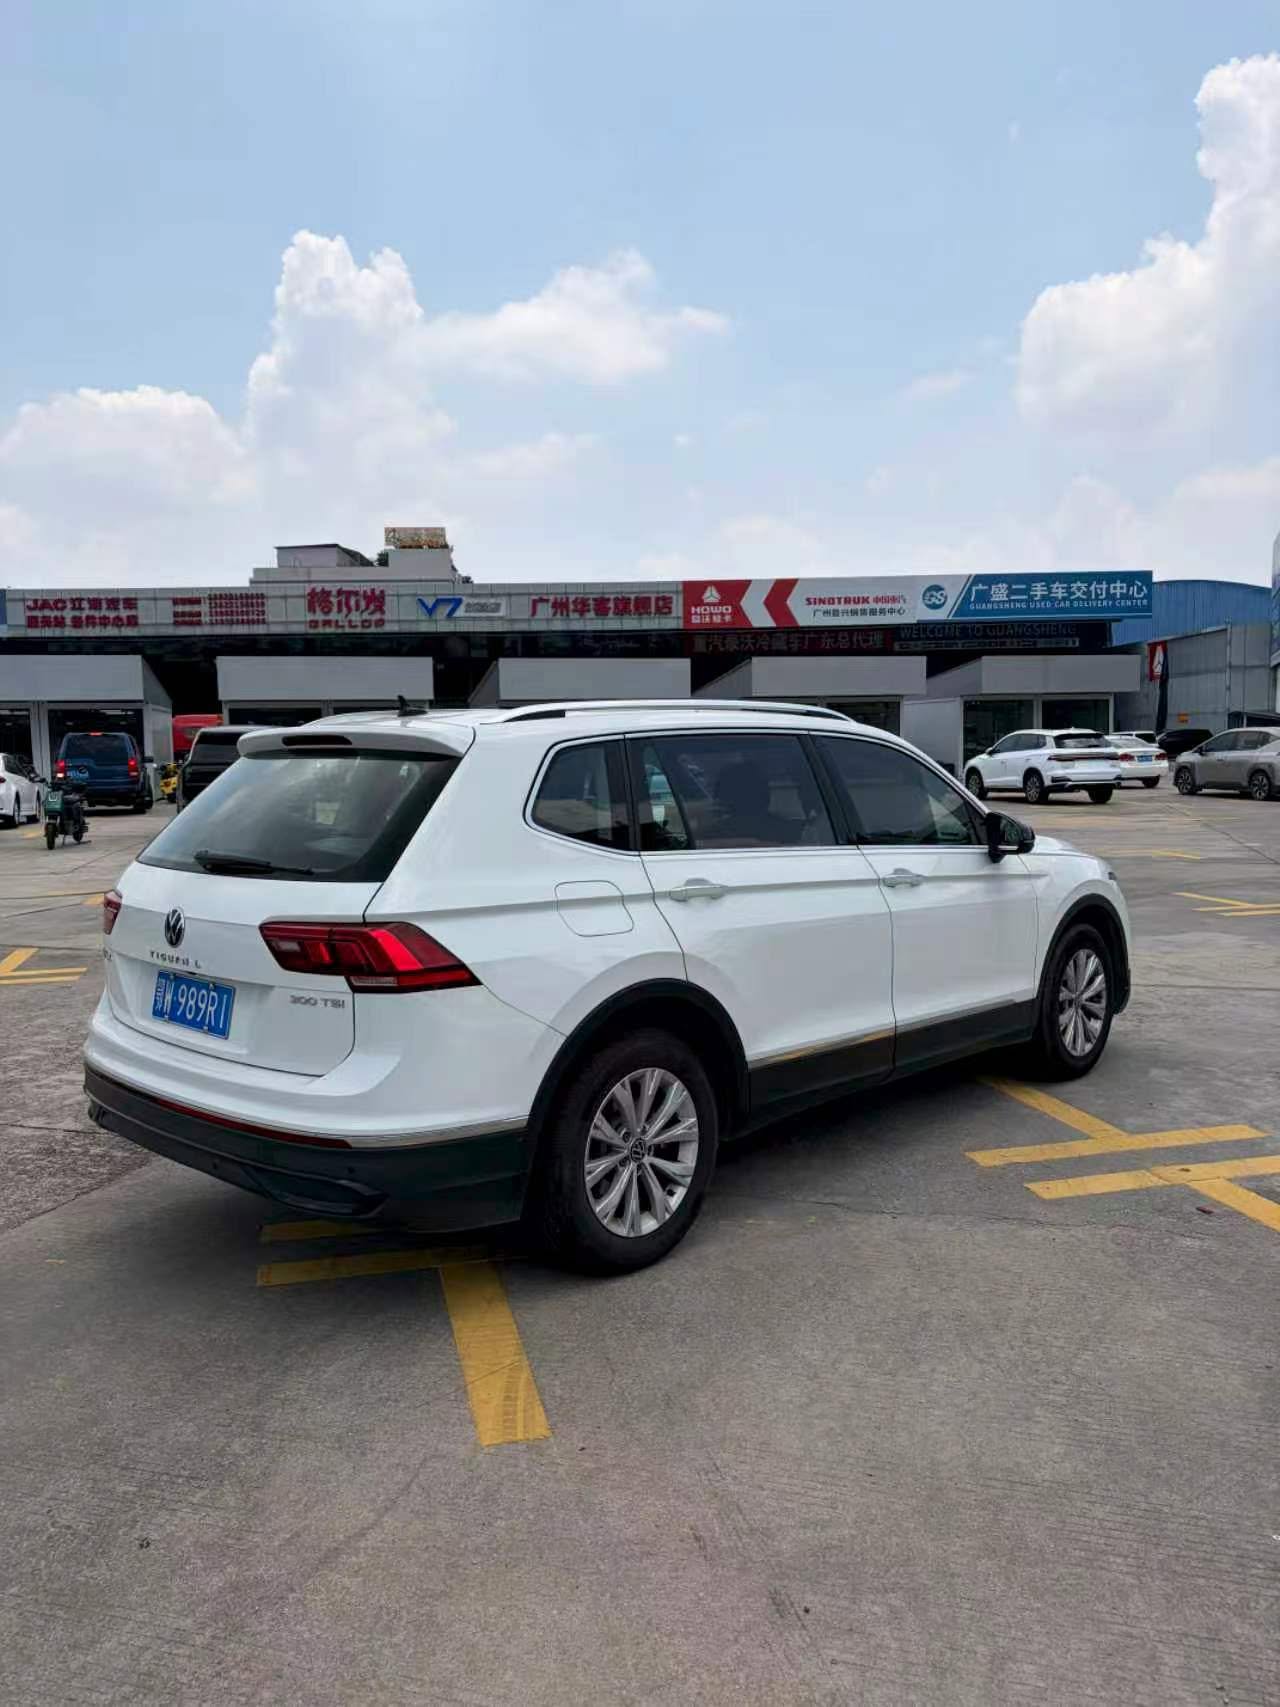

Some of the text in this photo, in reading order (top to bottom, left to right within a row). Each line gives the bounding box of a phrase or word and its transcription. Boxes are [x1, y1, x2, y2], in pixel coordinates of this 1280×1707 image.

[970, 580, 1148, 601] 广盛二手车交付中心
[805, 596, 870, 606] SINOTRUK
[969, 601, 1027, 610] GUANGSHENG
[1029, 601, 1051, 609] USED
[1073, 600, 1113, 608] DELIVERY
[1115, 599, 1148, 607] CENTER
[691, 605, 732, 614] HOWO
[320, 998, 346, 1009] TSI
